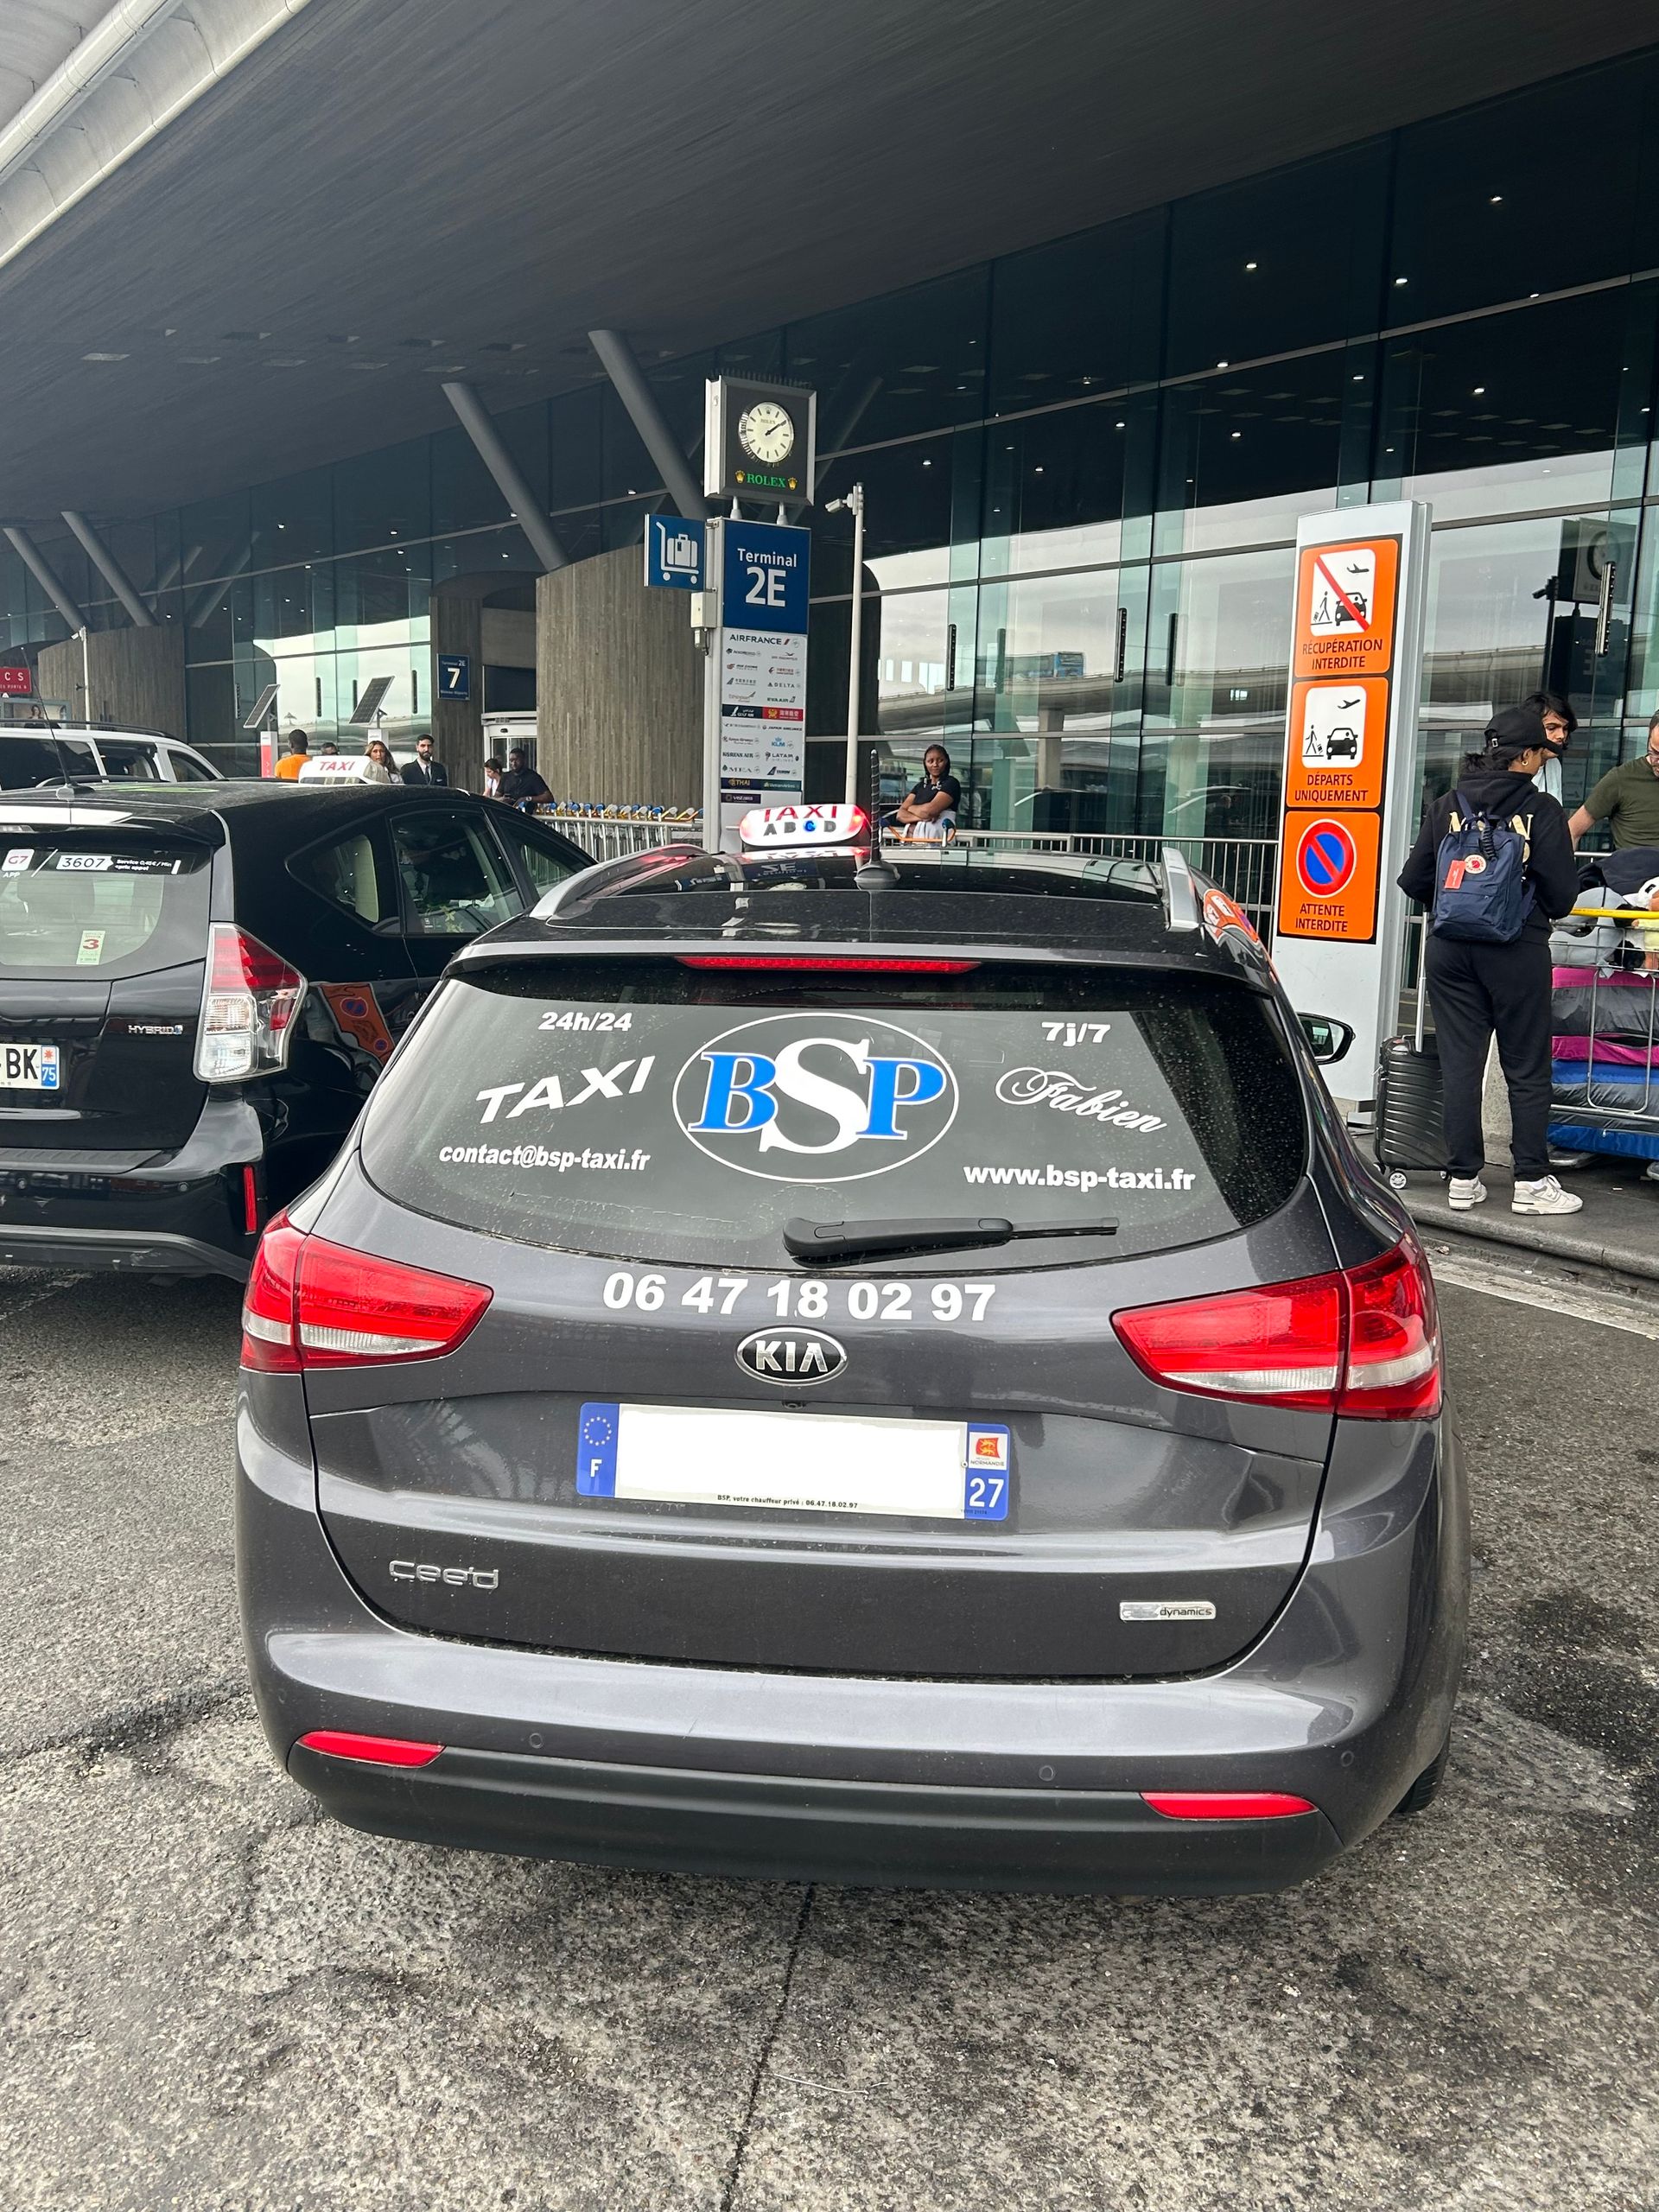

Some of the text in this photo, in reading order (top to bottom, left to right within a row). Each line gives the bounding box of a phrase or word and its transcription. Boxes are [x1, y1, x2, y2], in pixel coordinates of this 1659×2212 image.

[747, 474, 785, 487] ROLEX
[737, 548, 797, 567] Terminal
[746, 567, 786, 607] 2E
[729, 633, 782, 645] AIRFRANCE
[1302, 639, 1382, 655] RÉCUPÉRATION
[1312, 656, 1365, 670] INTERDITE
[448, 667, 461, 689] 7
[320, 760, 355, 771] TAXI
[1307, 771, 1353, 785] DÉPARTS
[1295, 790, 1369, 803] UNIQUEMENT
[763, 805, 837, 823] TAXI
[763, 820, 836, 836] A B C D
[8, 855, 29, 864] G7
[61, 858, 105, 868] 3607
[1300, 903, 1344, 917] ATTENTE
[1295, 918, 1348, 932] INTERDITE
[83, 938, 99, 950] 3
[128, 1025, 175, 1035] HYBRID
[537, 1012, 632, 1032] 24h/24
[1041, 1021, 1111, 1047] 7j/7
[41, 1066, 56, 1081] 75
[475, 1055, 656, 1124] TAXI
[688, 1038, 947, 1154] BSP
[995, 1066, 1168, 1134] Fabien
[439, 1144, 651, 1173] contact@bsp-taxi.fr
[963, 1164, 1196, 1192] www.bsp-taxi.fr
[603, 1272, 996, 1322] 06 47 18 02 97
[755, 1339, 829, 1372] KIA
[589, 1459, 603, 1478] F
[969, 1478, 1005, 1508] 27
[805, 1500, 858, 1509] 06.47.18.02.97
[1160, 1607, 1212, 1618] dynamics
